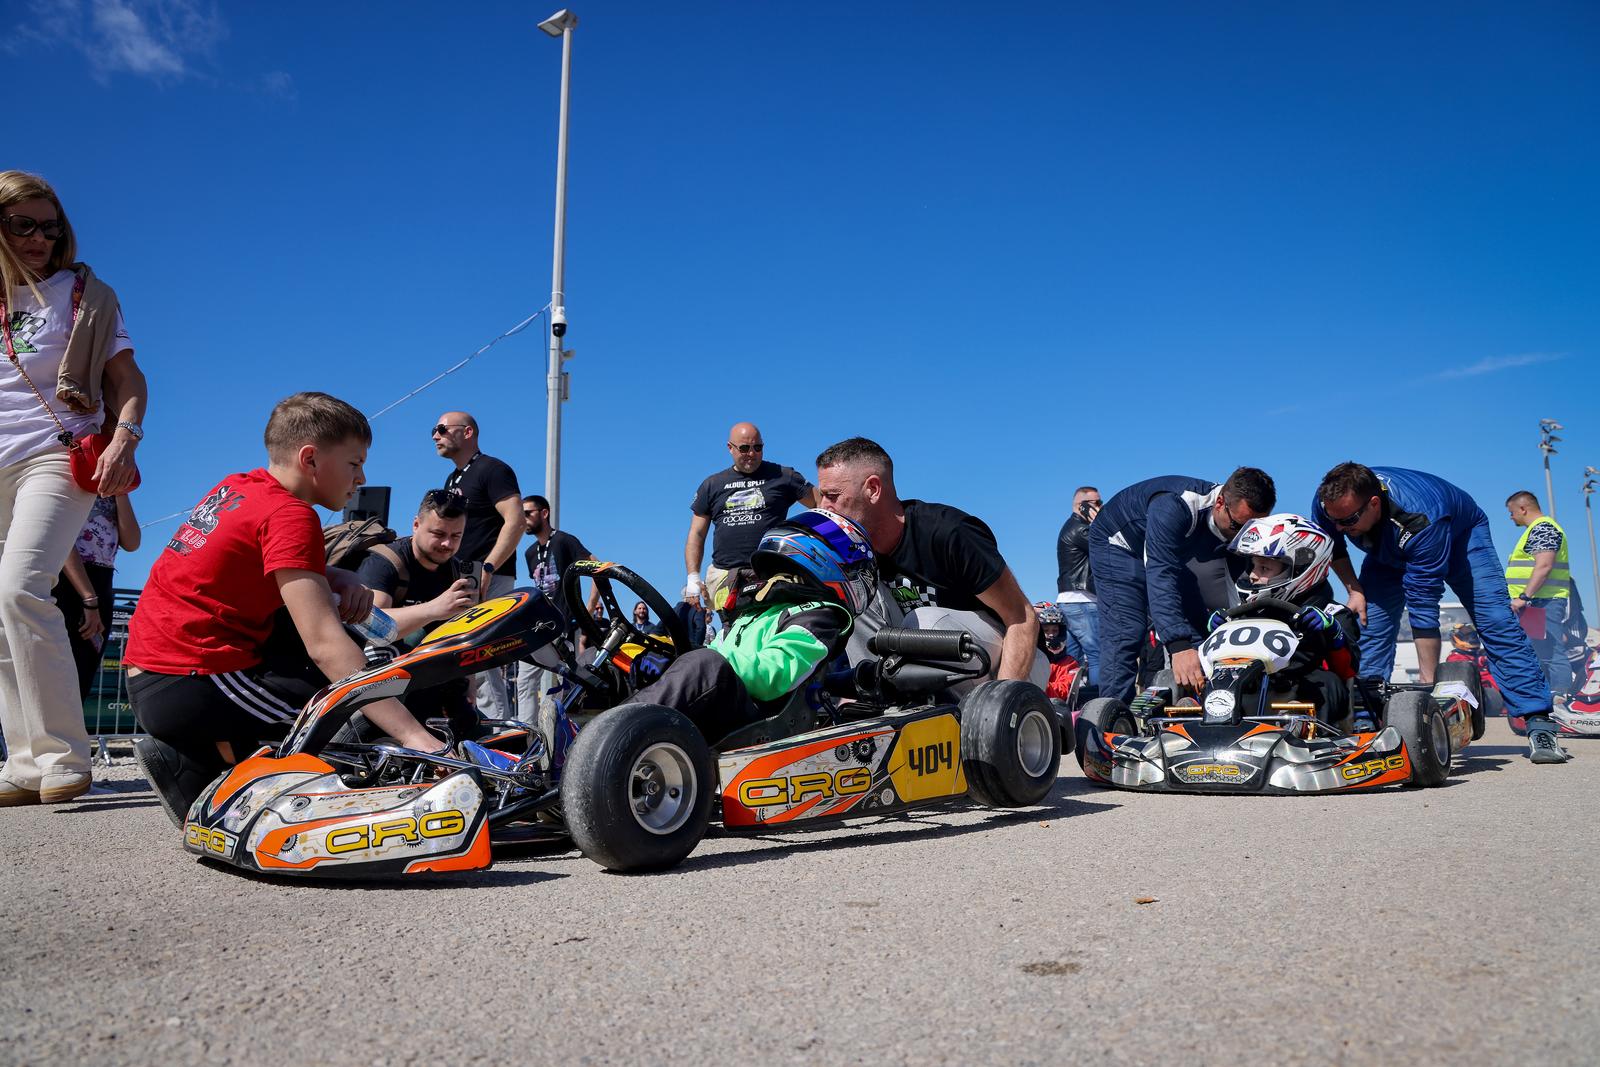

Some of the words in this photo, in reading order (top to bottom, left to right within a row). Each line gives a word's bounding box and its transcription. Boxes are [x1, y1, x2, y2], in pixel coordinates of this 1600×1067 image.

[1202, 626, 1296, 658] 406
[909, 741, 952, 776] 404
[1186, 764, 1240, 776] CRG
[1341, 755, 1405, 780] CRG
[738, 766, 872, 808] CRG
[188, 824, 226, 854] CRG
[325, 809, 466, 855] CRG
